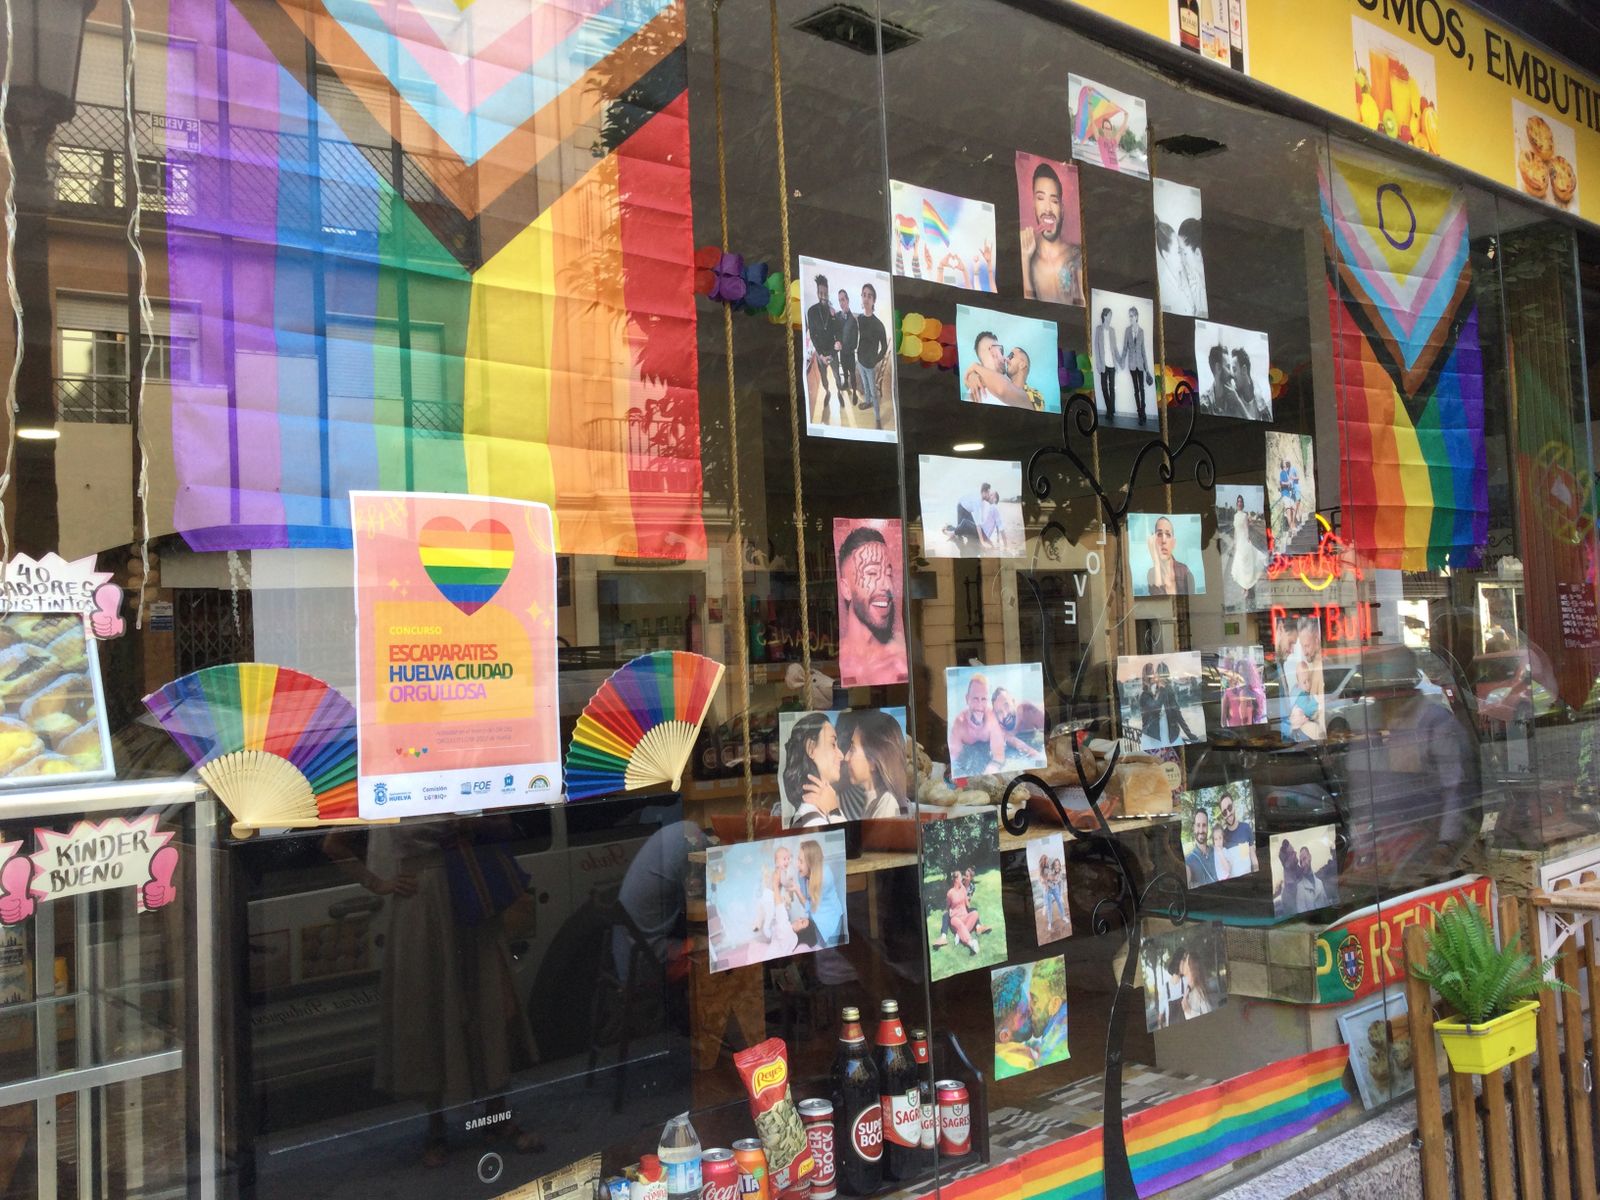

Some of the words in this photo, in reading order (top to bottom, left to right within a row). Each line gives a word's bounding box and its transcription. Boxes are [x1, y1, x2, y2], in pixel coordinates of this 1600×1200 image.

[17, 564, 51, 584] 40
[389, 626, 442, 635] CONCURSO
[1325, 603, 1371, 641] Bull
[389, 644, 498, 662] ESCAPARATES
[389, 665, 454, 682] HUELVA
[455, 663, 513, 680] CIUDAD
[389, 684, 487, 703] ORGULLOSA
[473, 781, 492, 790] FOE
[50, 862, 124, 892] BUENO
[757, 1066, 783, 1086] Reyes
[465, 1110, 512, 1130] SAMSUNG
[943, 1116, 970, 1128] SAGRES
[823, 1130, 833, 1174] BOCK
